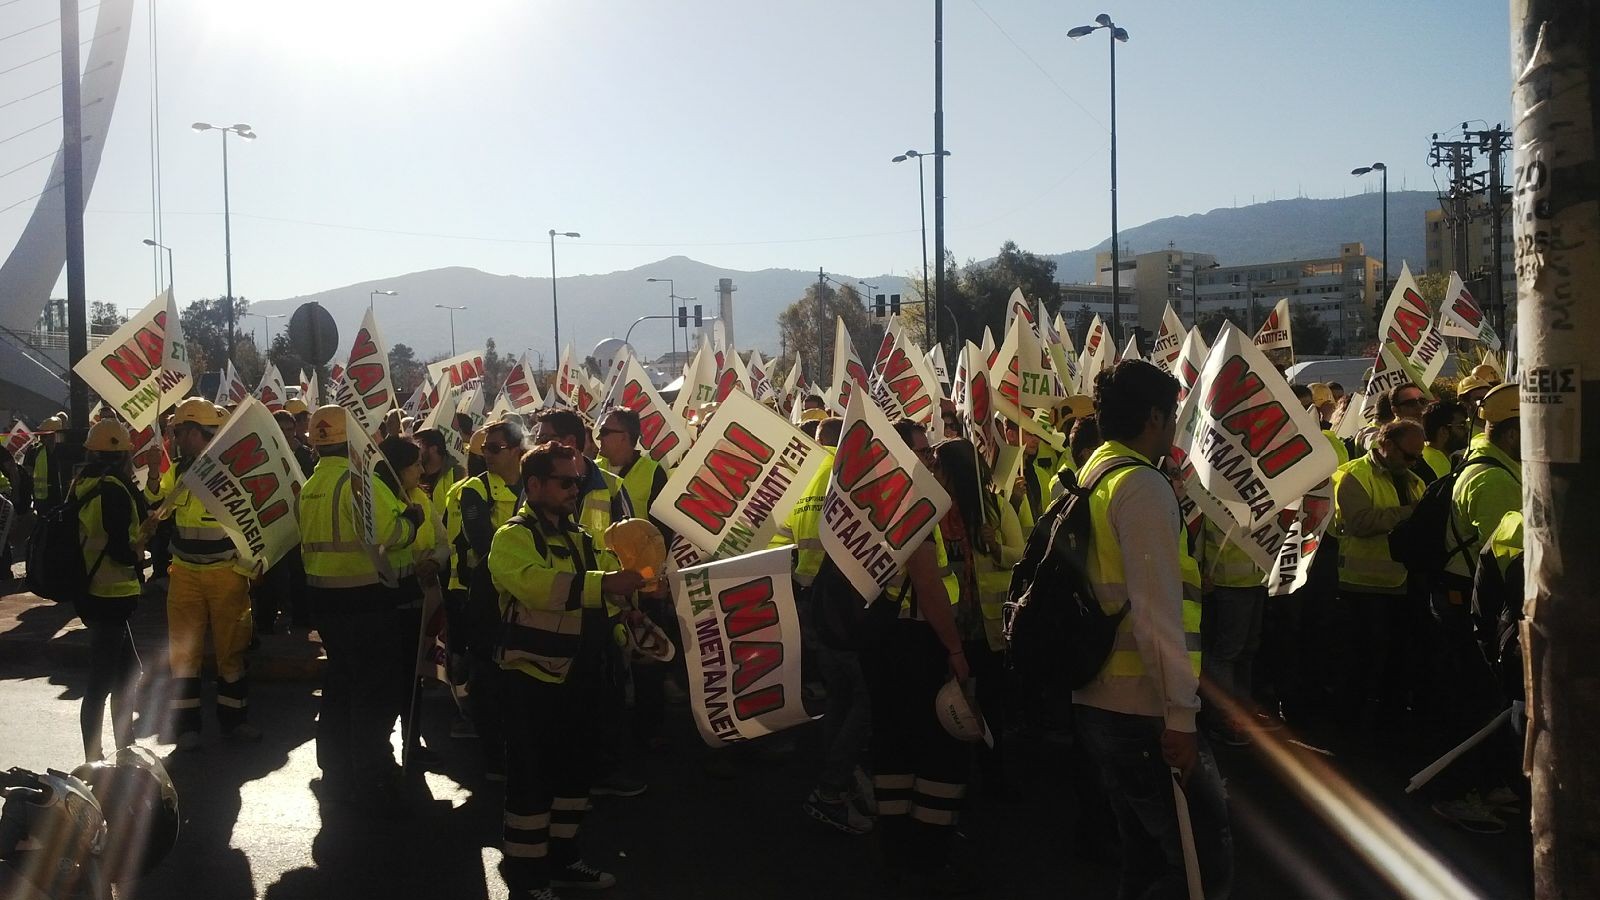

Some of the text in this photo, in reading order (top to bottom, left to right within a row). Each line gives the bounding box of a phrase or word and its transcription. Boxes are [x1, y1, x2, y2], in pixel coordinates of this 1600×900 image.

[883, 348, 932, 417] ΝΑΙ
[1022, 371, 1050, 396] ΣΤΑ
[1205, 355, 1313, 480] ΝΑΙ
[1519, 369, 1576, 393] ΑΞΕΙΣ
[204, 471, 266, 557] ΜΕΤΑΛΛΕΙΑ
[218, 432, 290, 529] ΝΑΙ
[674, 421, 775, 536] ΝΑΙ
[711, 519, 756, 558] ΤΗΝ
[742, 435, 812, 529] ΑΝΑΠΤΥΞΗ
[833, 419, 937, 551] ΝΑΙ
[684, 567, 714, 617] ΣΤΑ
[718, 575, 786, 721] ΝΑΙ
